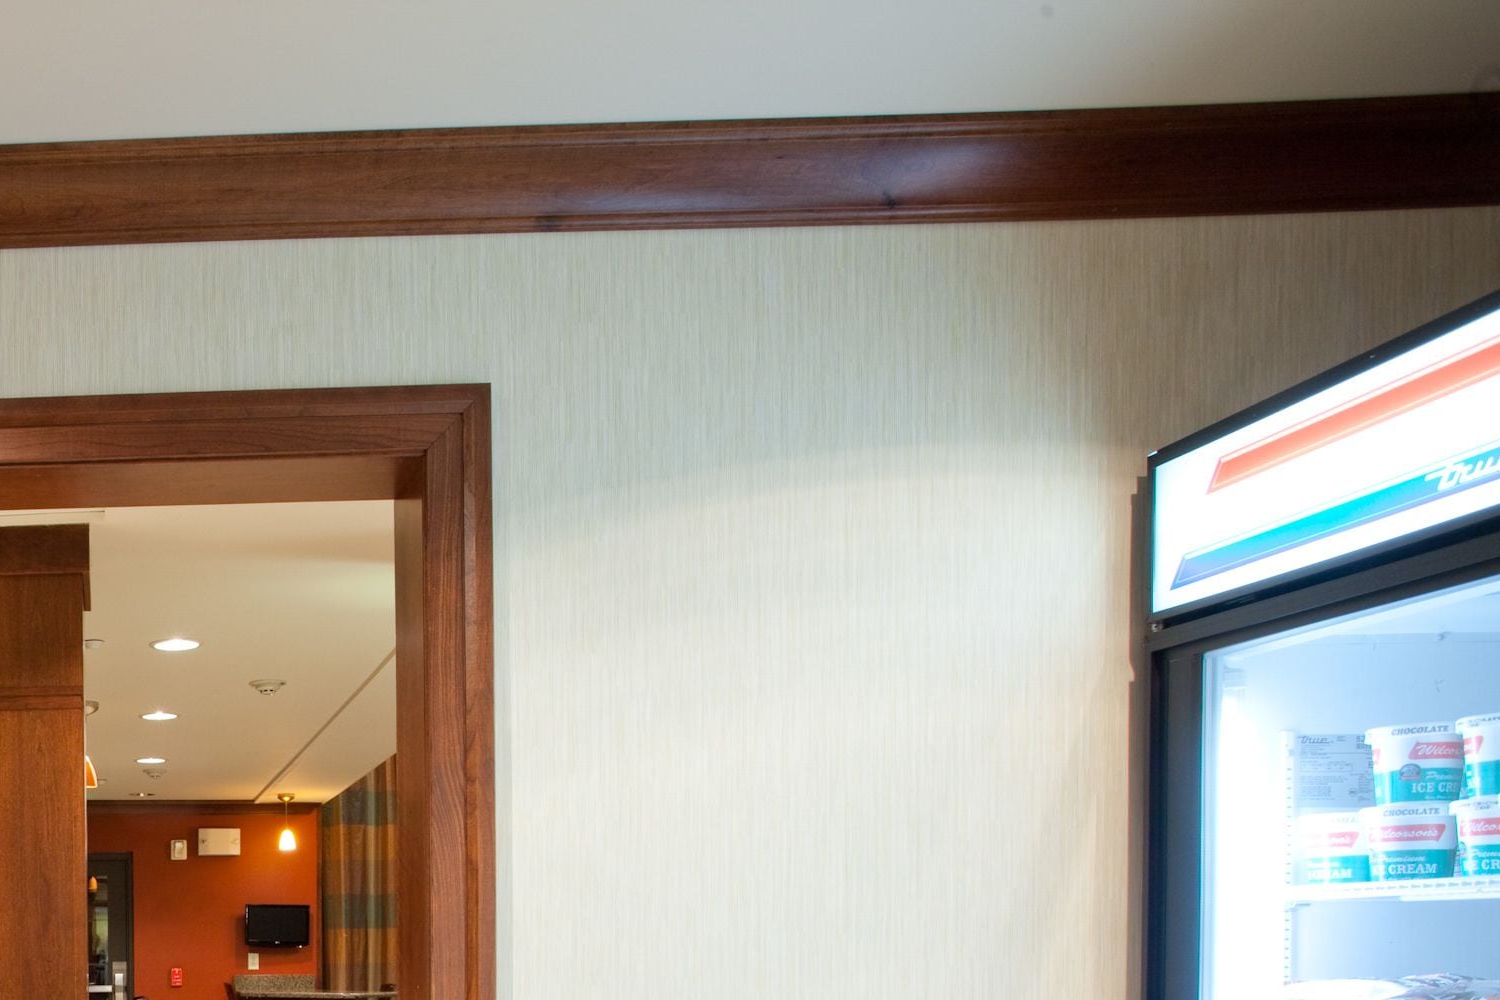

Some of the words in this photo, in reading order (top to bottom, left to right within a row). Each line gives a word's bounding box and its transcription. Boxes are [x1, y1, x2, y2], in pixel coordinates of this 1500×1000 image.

[1424, 455, 1500, 492] Tru
[1391, 725, 1449, 736] CHOCOLATE
[1411, 782, 1435, 793] ICE
[1383, 807, 1440, 817] CHOCOLATE
[1388, 863, 1437, 874] CREAM
